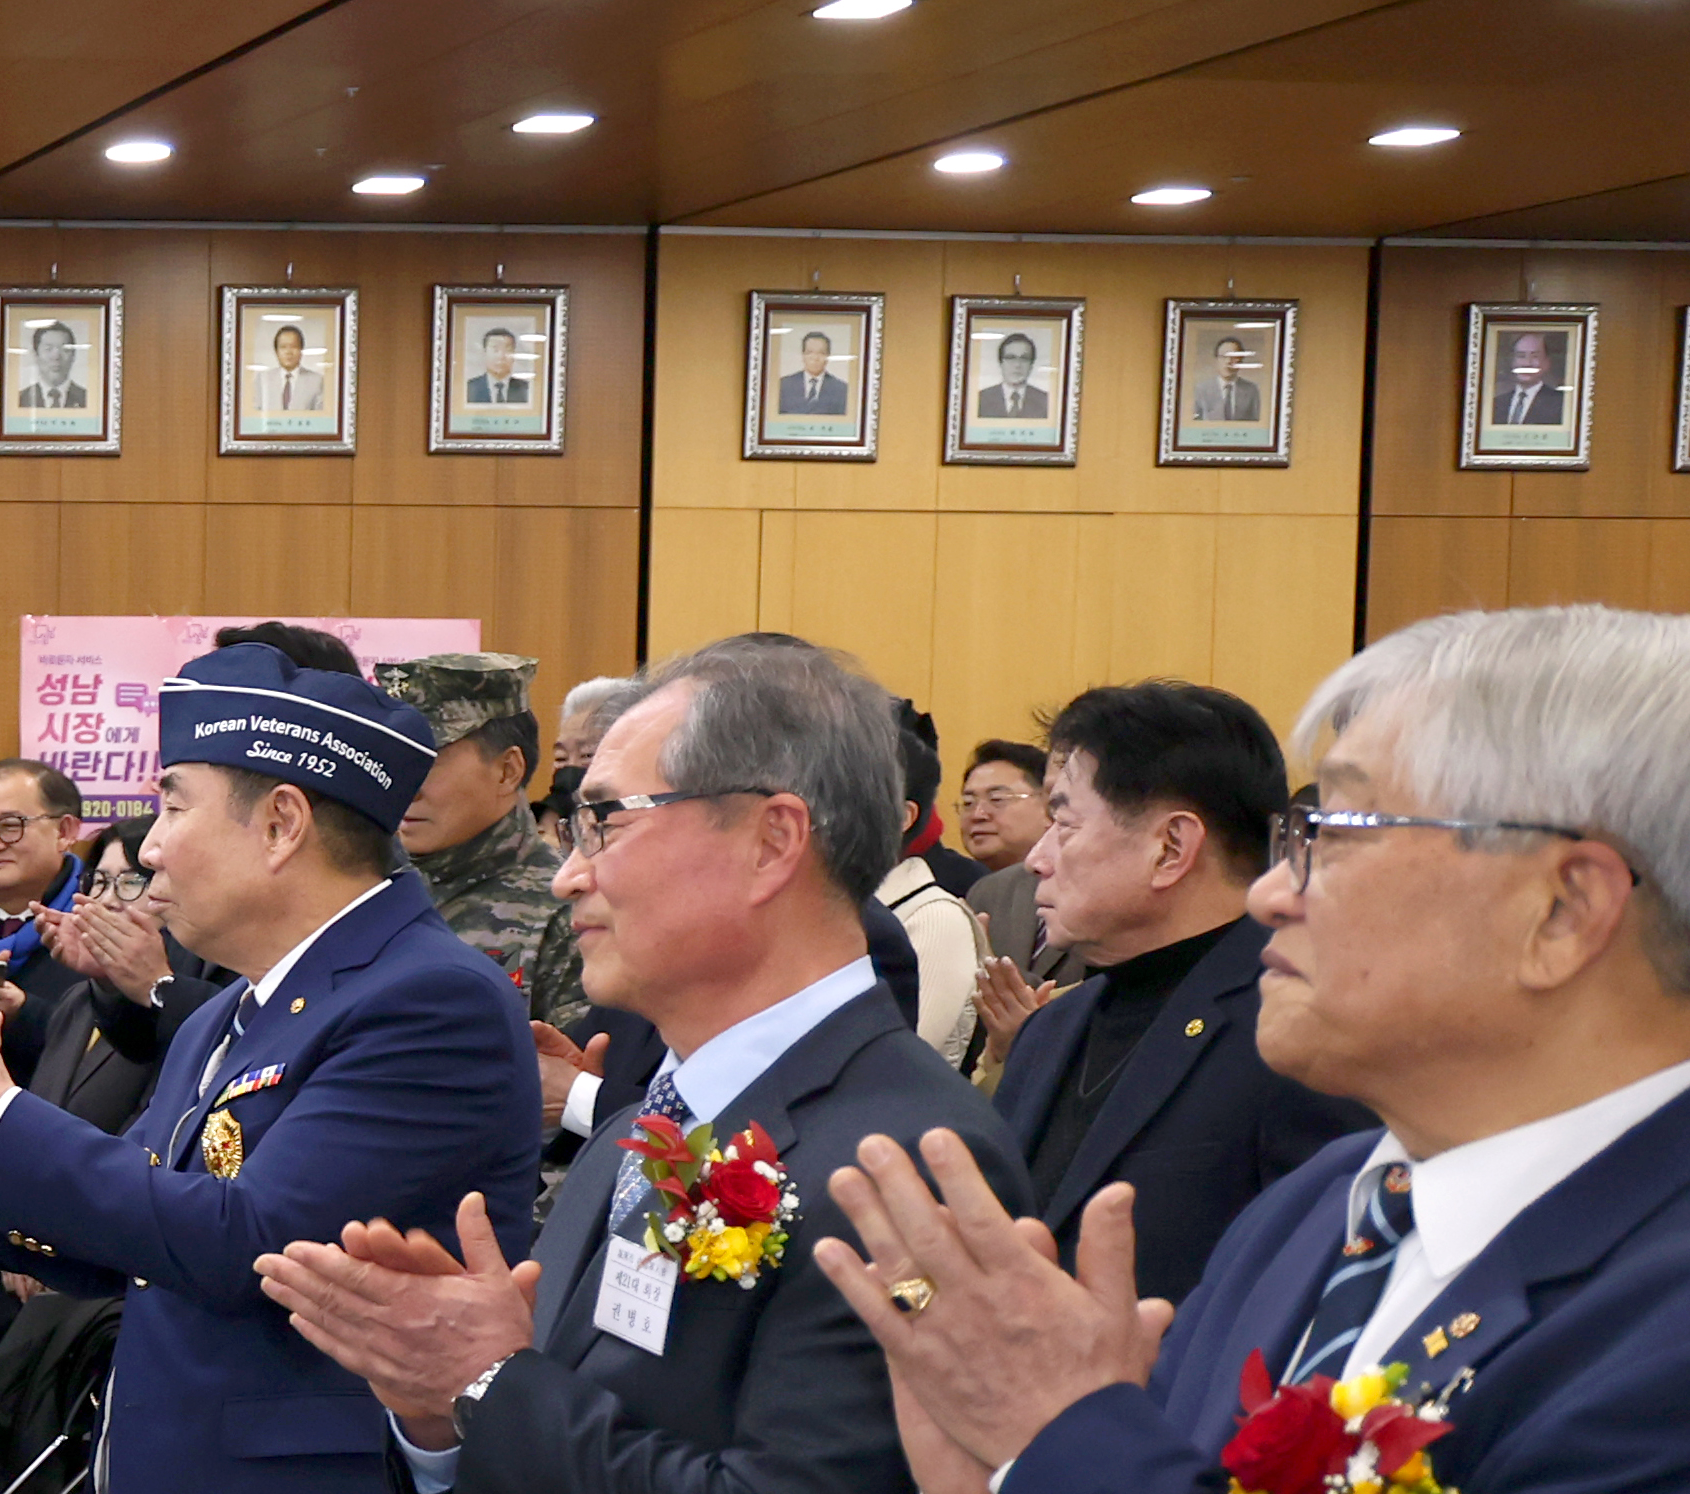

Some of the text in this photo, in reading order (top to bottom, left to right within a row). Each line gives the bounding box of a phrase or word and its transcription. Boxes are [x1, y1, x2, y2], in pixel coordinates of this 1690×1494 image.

[36, 673, 104, 706] 성남
[194, 715, 393, 791] Korean Veterans Association
[245, 740, 337, 778] Since 1952
